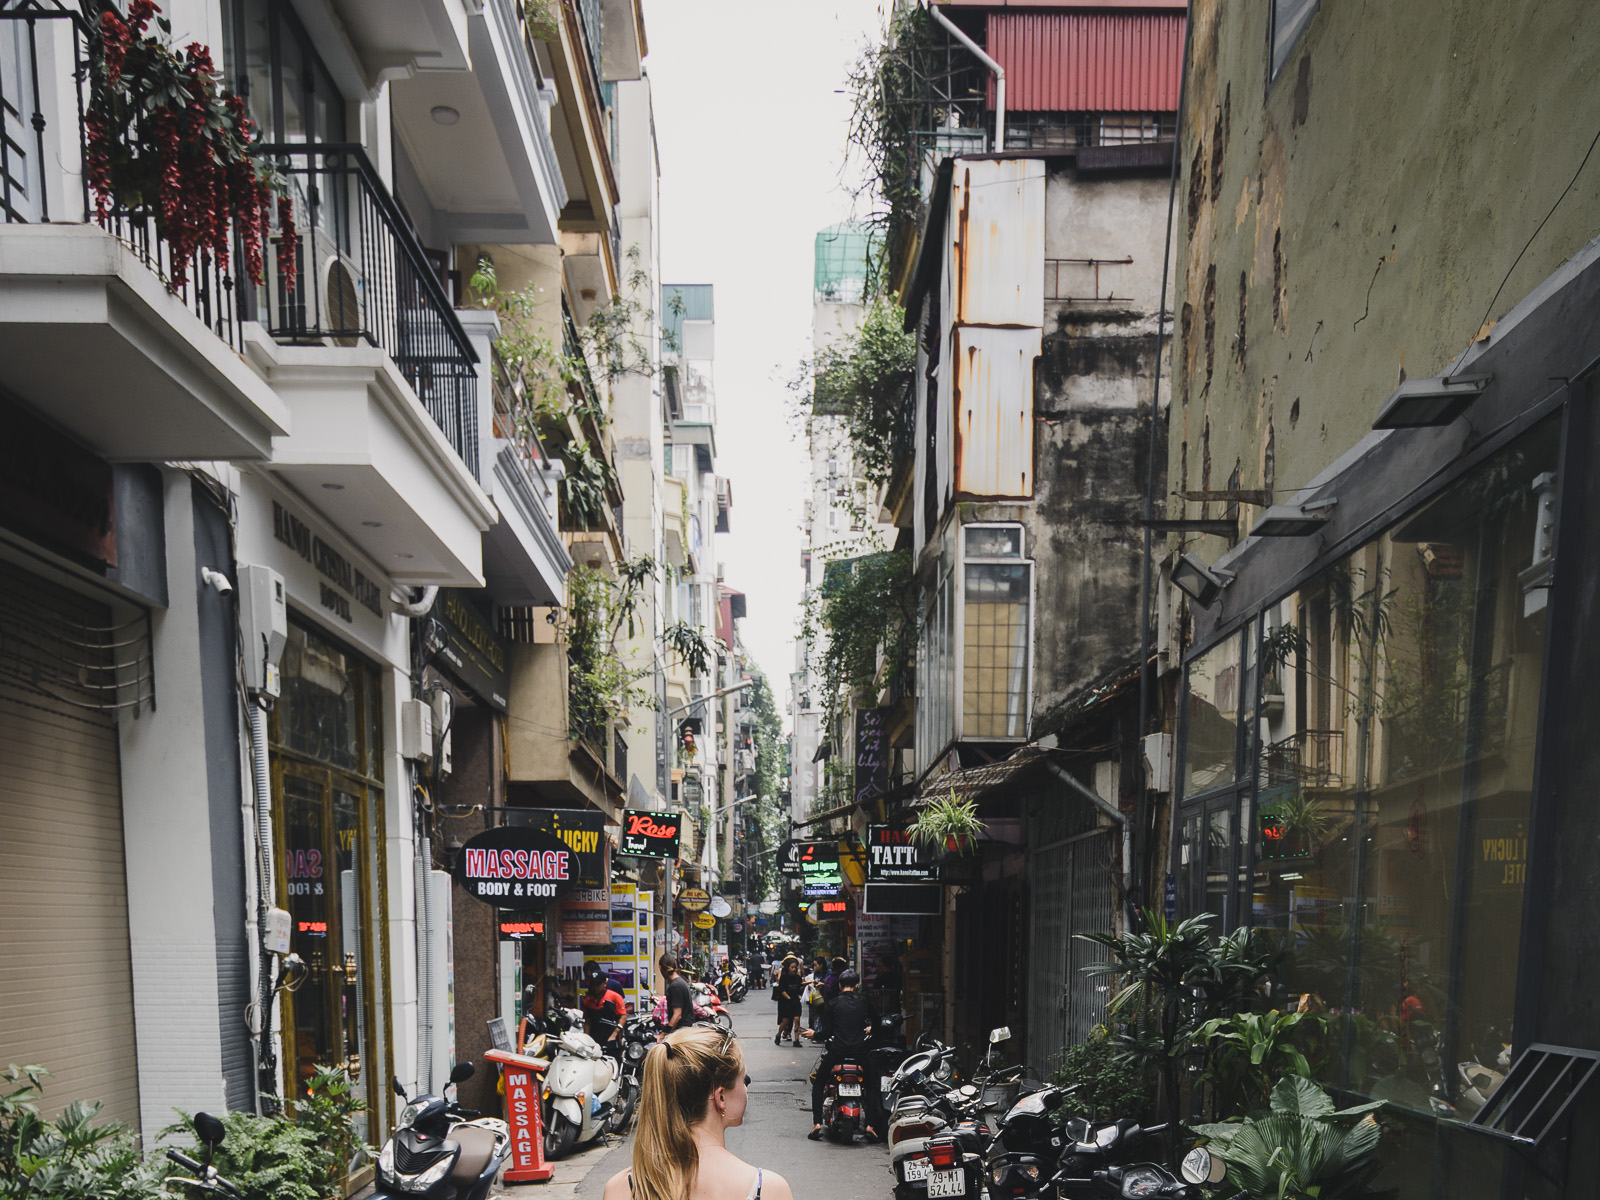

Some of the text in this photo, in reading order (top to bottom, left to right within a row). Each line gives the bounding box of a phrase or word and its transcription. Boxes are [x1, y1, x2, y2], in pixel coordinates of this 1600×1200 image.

[627, 815, 677, 839] Rose
[466, 848, 570, 881] MASSAGE
[478, 882, 557, 897] BODY & FOOT
[509, 1074, 532, 1166] MASSAGE
[932, 1171, 959, 1184] 29-M1
[930, 1182, 963, 1197] 524.44
